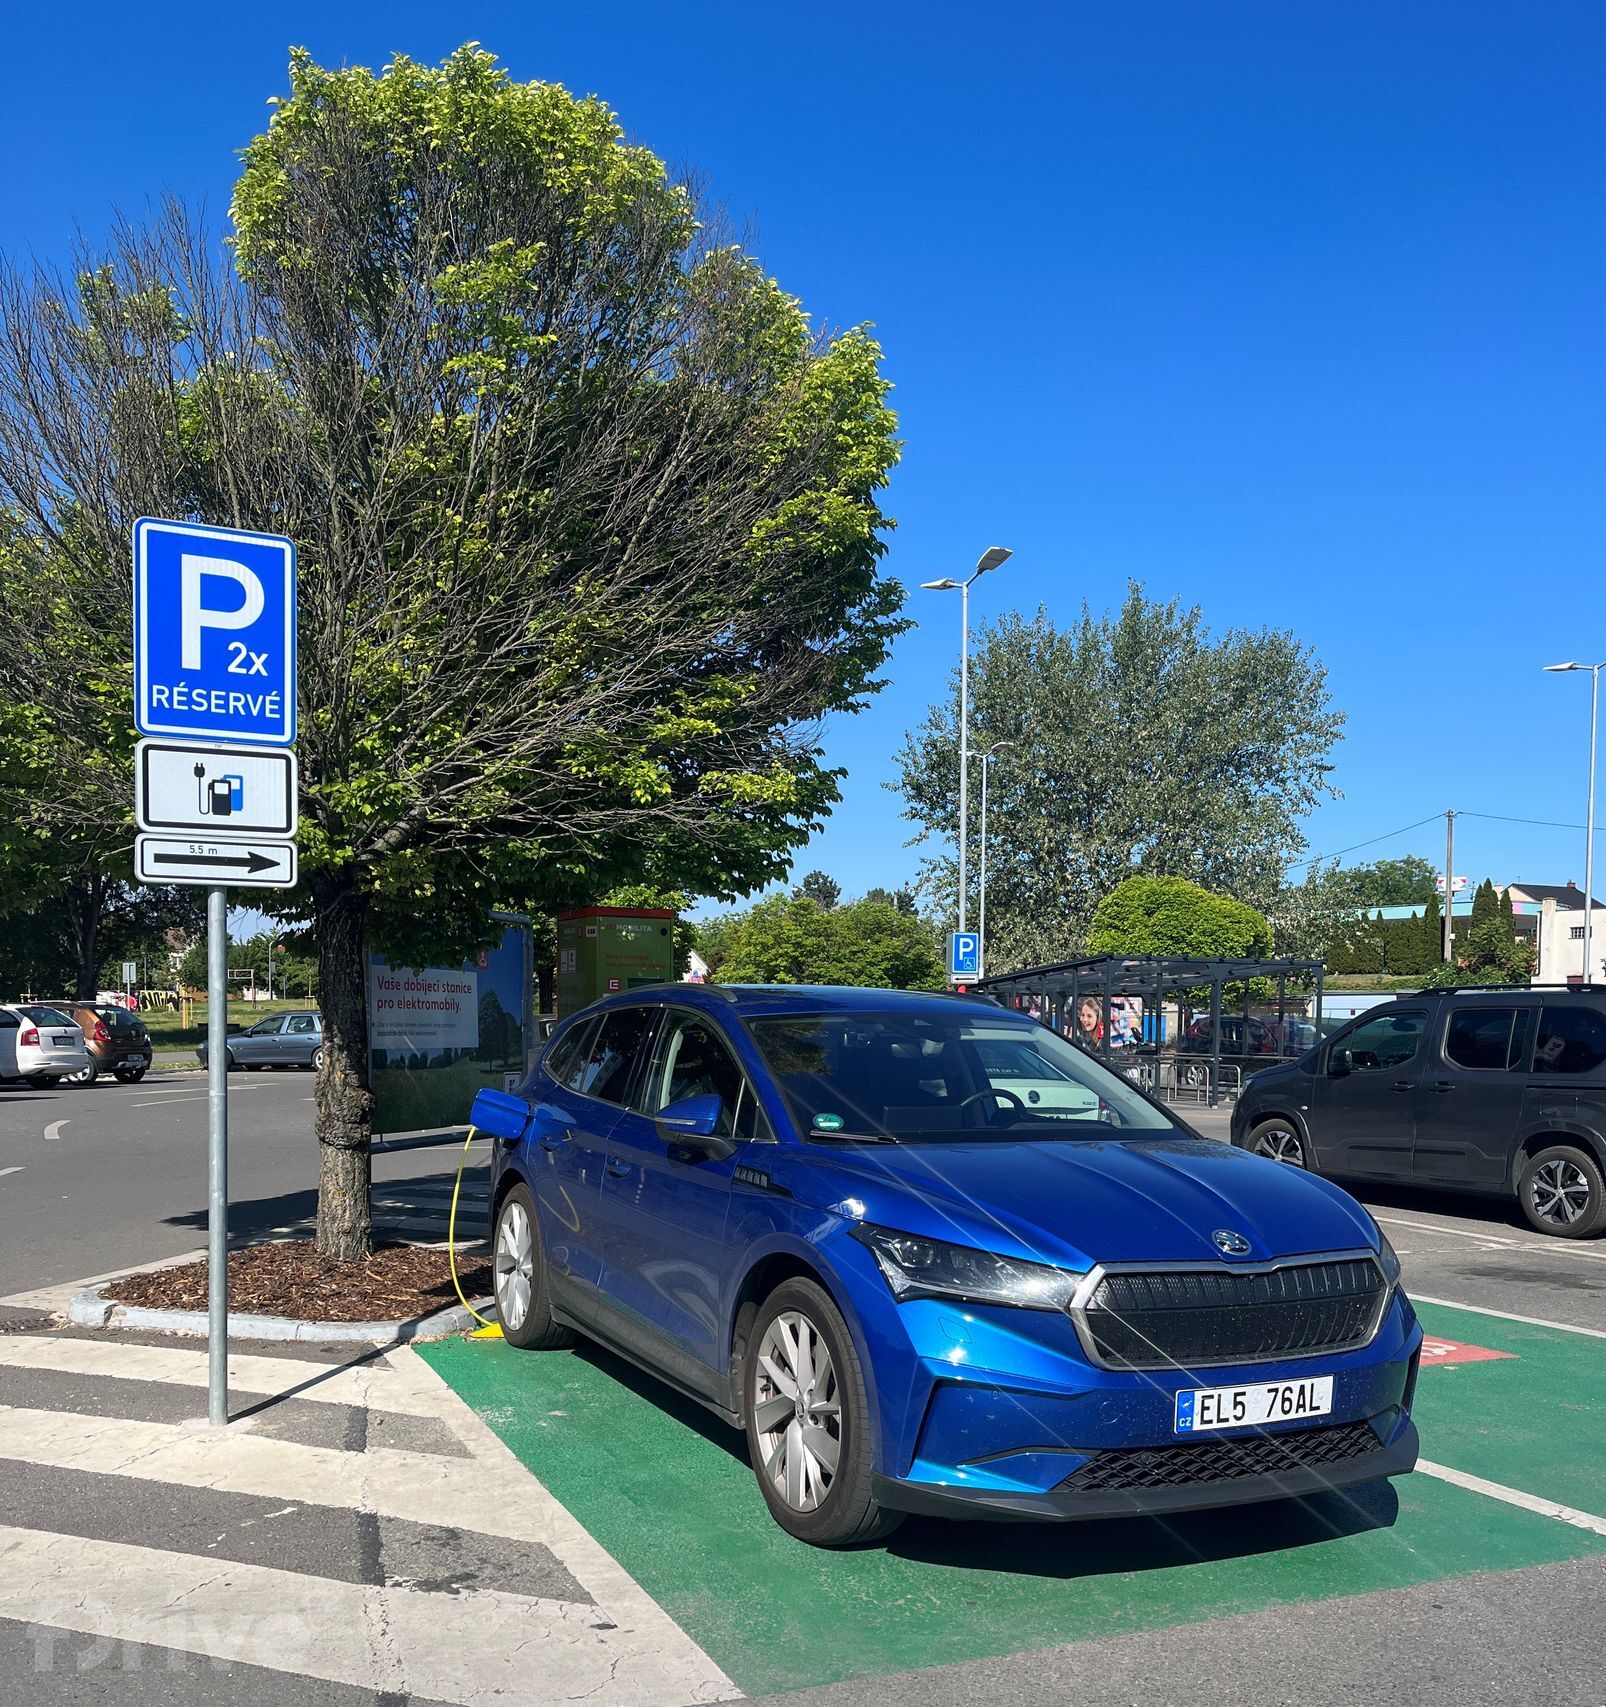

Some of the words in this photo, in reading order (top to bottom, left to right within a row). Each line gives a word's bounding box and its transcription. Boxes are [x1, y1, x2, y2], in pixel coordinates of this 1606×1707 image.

[181, 553, 265, 671] P
[227, 641, 269, 676] 2x
[152, 682, 281, 718] RÉSERVÉ
[189, 844, 204, 855] 5.5
[208, 847, 218, 855] m
[959, 937, 974, 961] P
[377, 975, 401, 991] Vaše
[442, 981, 472, 994] stanice
[377, 999, 394, 1012] pro
[397, 996, 462, 1014] elektromobily.
[1200, 1391, 1247, 1426] EL5
[1266, 1383, 1321, 1418] 76AL
[1179, 1417, 1192, 1427] CZ
